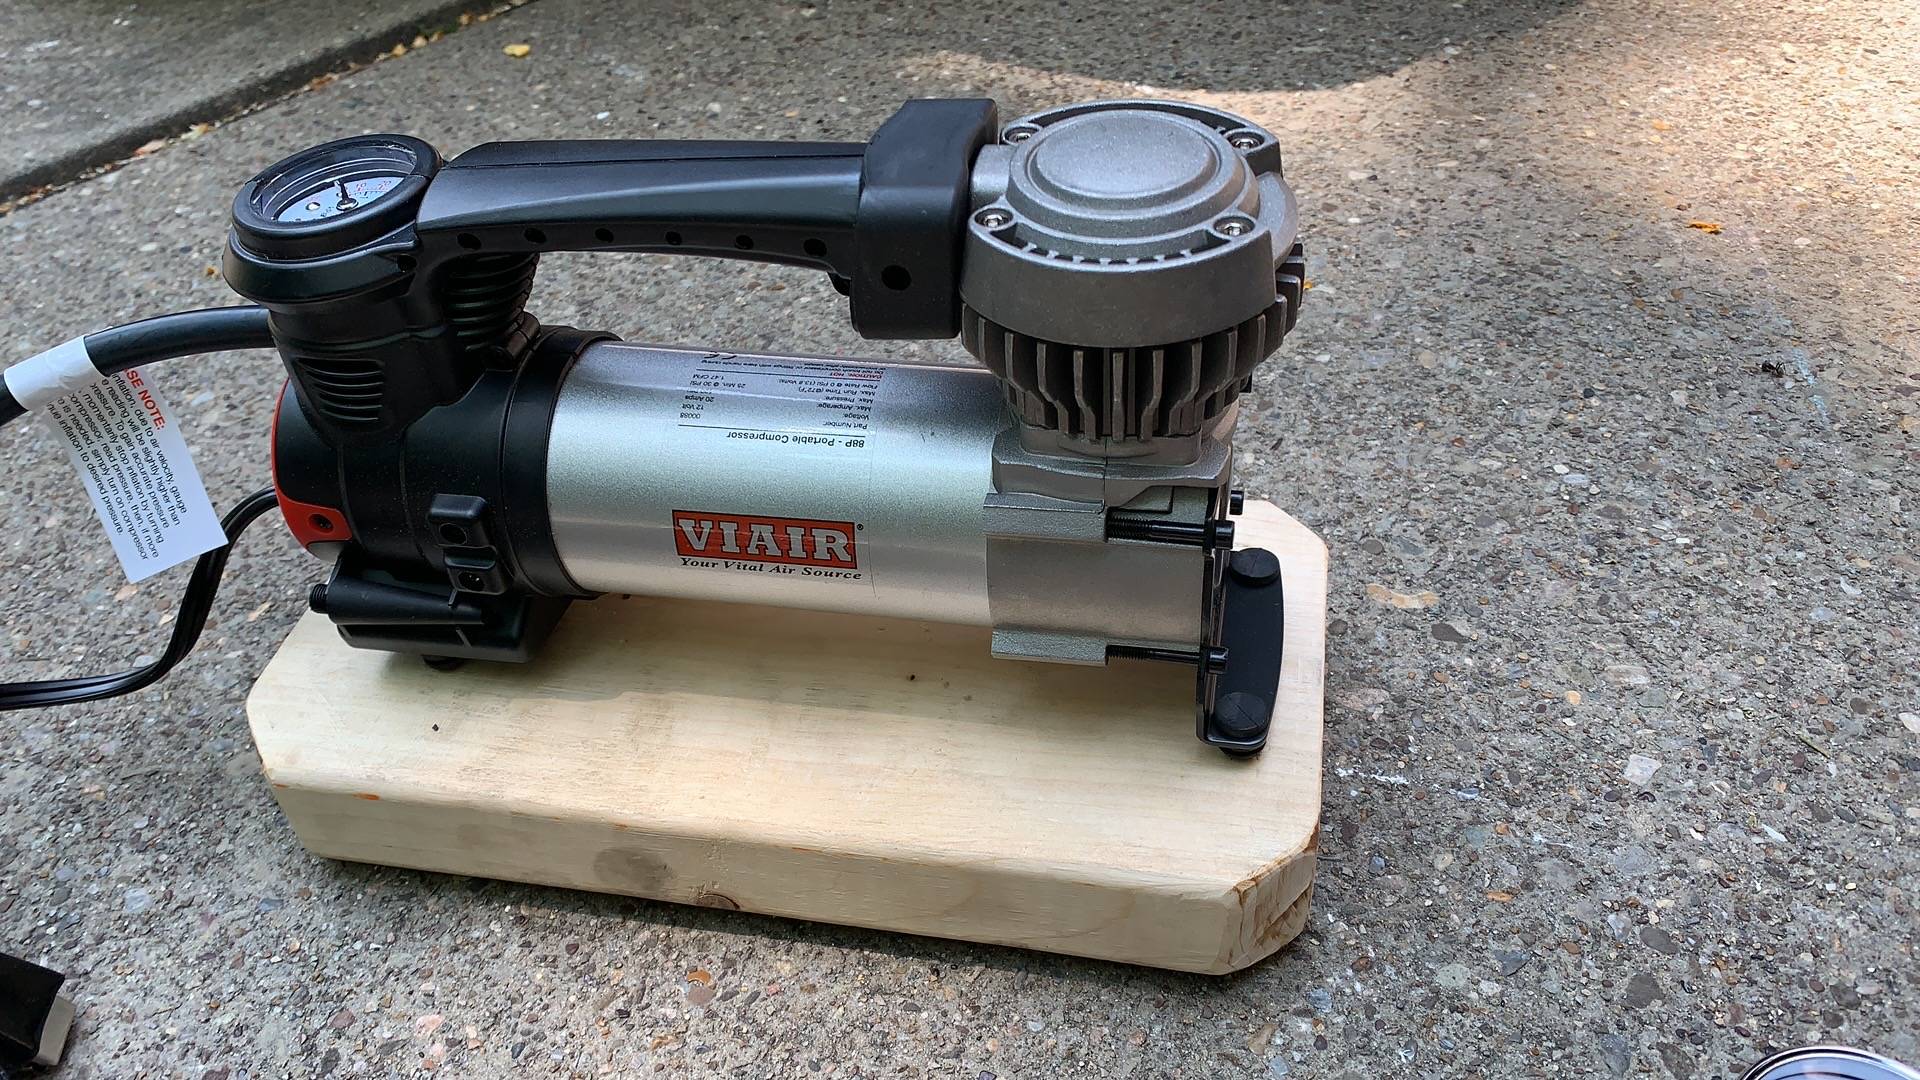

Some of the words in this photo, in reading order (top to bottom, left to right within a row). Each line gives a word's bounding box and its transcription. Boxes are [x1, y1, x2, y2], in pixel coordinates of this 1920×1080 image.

[107, 385, 129, 419] reading
[127, 418, 139, 433] will
[135, 433, 145, 446] be
[142, 446, 159, 477] slightly
[155, 477, 171, 505] higher
[168, 505, 180, 525] than
[134, 408, 148, 427] due
[145, 427, 154, 438] to
[150, 437, 159, 450] air
[156, 450, 174, 485] velocity,
[170, 486, 186, 514] gauge
[138, 389, 165, 430] NOTE:
[726, 432, 788, 443] Compressor
[792, 436, 835, 446] Portable
[845, 440, 864, 448] 88P
[59, 419, 82, 452] inflation
[81, 452, 89, 462] to
[86, 463, 107, 495] desired
[102, 496, 124, 535] pressure.
[62, 405, 70, 413] is
[68, 413, 94, 448] needed,
[91, 448, 109, 477] simply
[107, 477, 118, 495] turn
[115, 497, 123, 509] on
[120, 510, 148, 560] compressor
[83, 393, 119, 445] momentarily
[115, 445, 129, 466] stop
[126, 466, 144, 499] inflation
[141, 499, 149, 513] by
[147, 513, 163, 544] turning
[101, 443, 116, 463] read
[131, 505, 143, 527] then,
[145, 535, 158, 558] more
[115, 420, 124, 431] To
[120, 432, 135, 451] gain
[132, 452, 153, 490] accurate
[148, 491, 169, 529] pressure
[678, 519, 853, 562] VIAIR
[680, 558, 718, 568] Your
[723, 561, 763, 572] Vital
[769, 565, 795, 574] Air
[802, 567, 862, 579] Source
